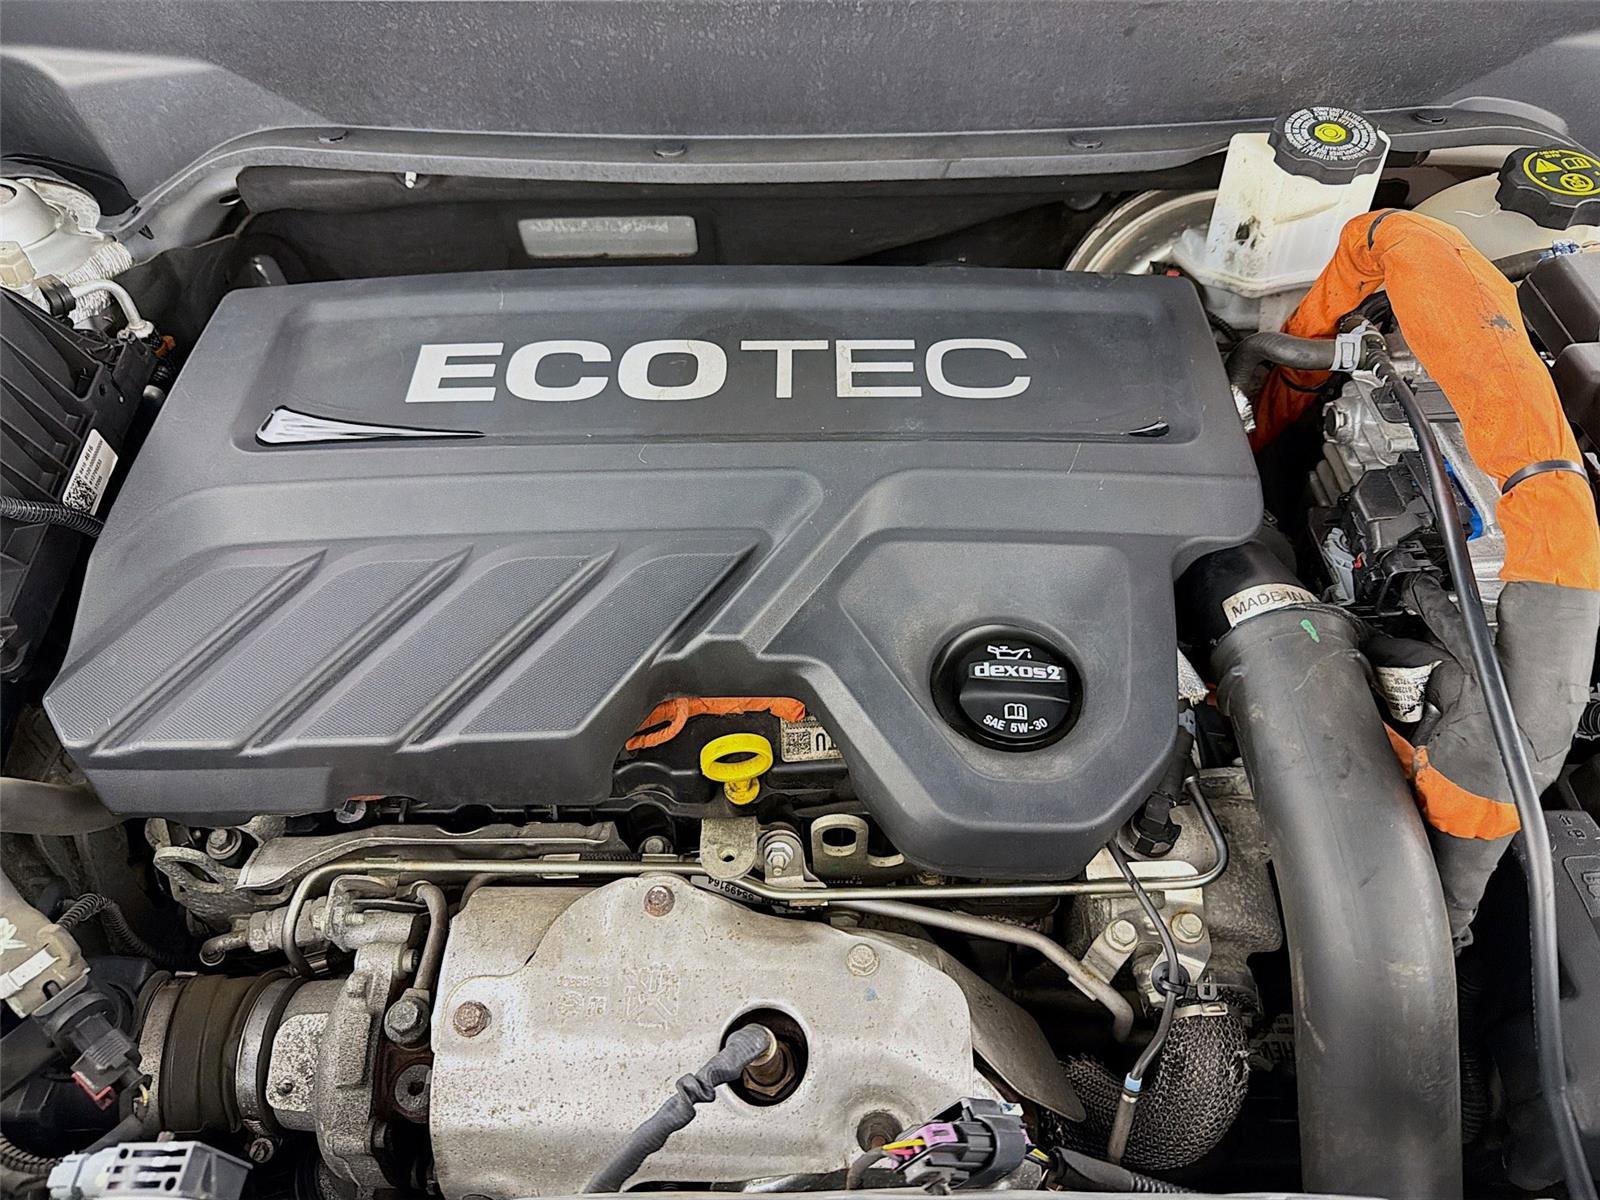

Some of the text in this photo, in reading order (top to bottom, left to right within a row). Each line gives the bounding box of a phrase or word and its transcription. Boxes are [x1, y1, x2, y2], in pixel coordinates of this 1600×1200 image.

[405, 339, 1032, 403] ECOTEC
[1231, 591, 1281, 618] MADE
[1286, 591, 1305, 602] IN
[974, 662, 1061, 680] dexos2
[983, 714, 1048, 733] SAE 5W-30
